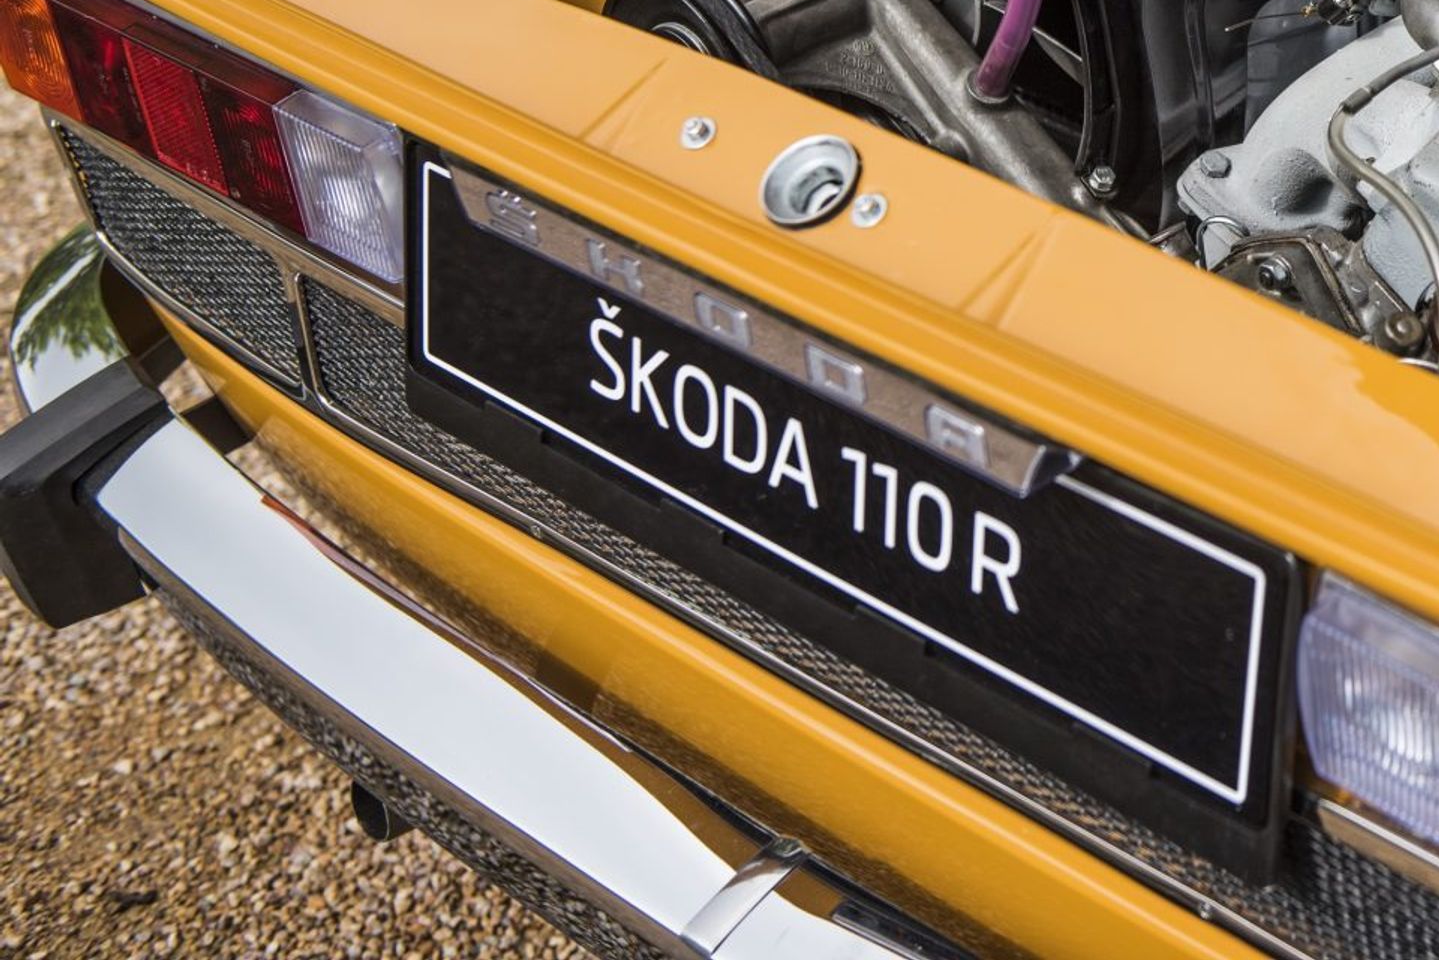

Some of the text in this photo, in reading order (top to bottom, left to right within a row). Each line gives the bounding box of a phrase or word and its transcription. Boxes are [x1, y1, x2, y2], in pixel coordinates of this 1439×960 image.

[589, 297, 1020, 613] ŠKODA 110 R
